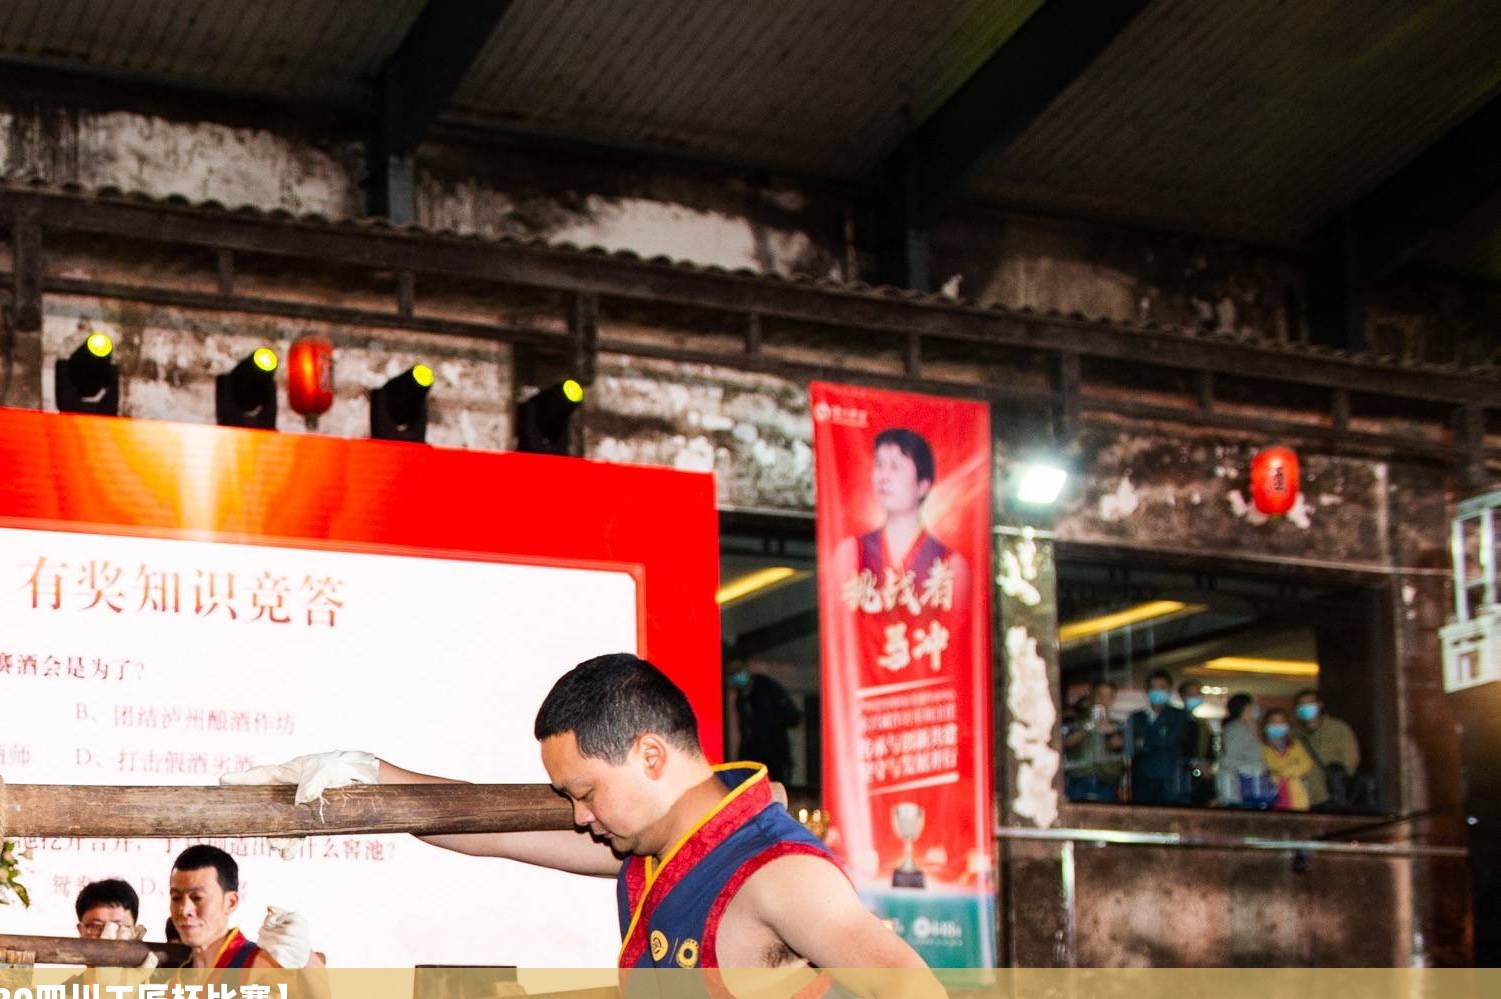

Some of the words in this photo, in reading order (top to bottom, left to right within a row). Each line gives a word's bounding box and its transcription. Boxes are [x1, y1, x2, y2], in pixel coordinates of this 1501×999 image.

[23, 553, 346, 629] 有奖知识竞答
